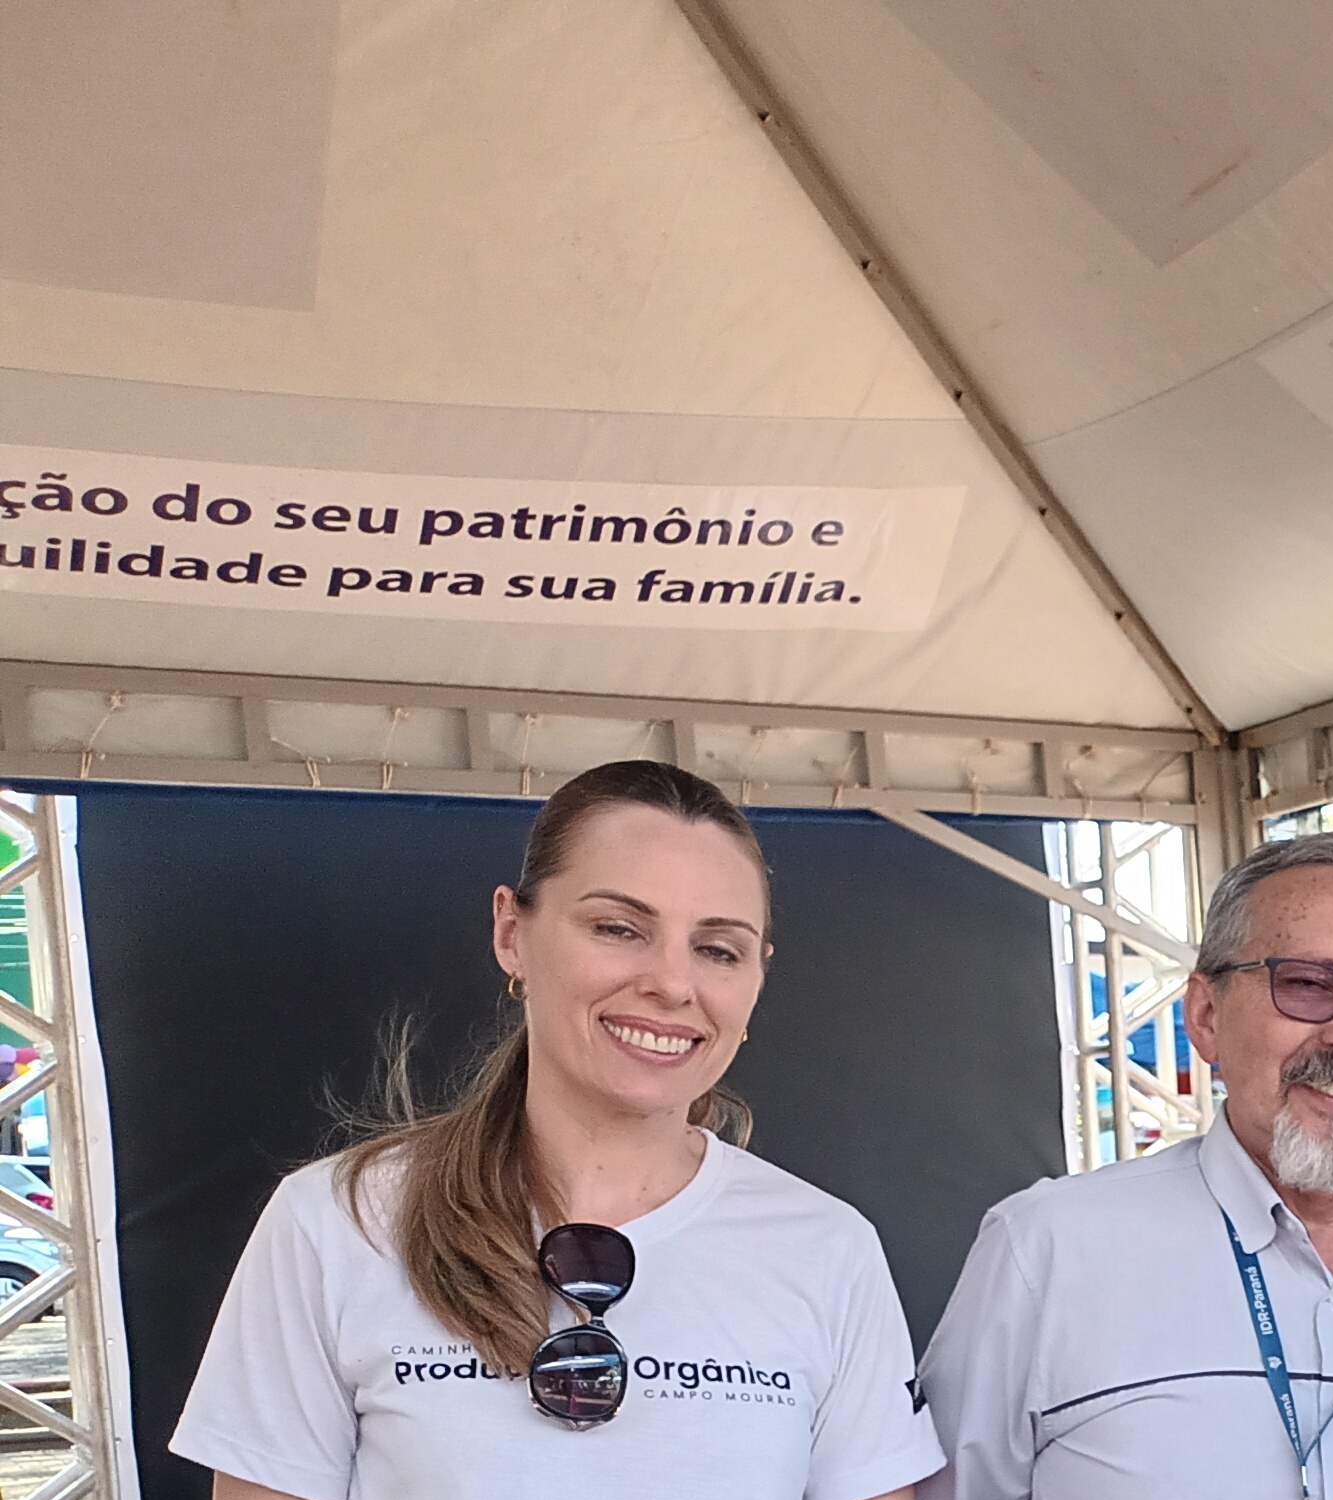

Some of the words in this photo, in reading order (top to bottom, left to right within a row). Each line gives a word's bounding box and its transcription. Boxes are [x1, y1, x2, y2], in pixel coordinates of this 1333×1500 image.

[152, 483, 252, 525] do
[274, 501, 398, 534] seu
[419, 503, 793, 547] patrimônio
[811, 519, 845, 547] e
[327, 565, 484, 597] para
[505, 574, 617, 601] sua
[636, 570, 862, 605] família.
[1244, 1266, 1273, 1335] IDR-Paraná
[391, 1344, 473, 1357] CAMINH
[634, 1355, 791, 1391] Orgânica
[643, 1388, 713, 1401] CAMPO
[726, 1391, 797, 1407] MOURÃO
